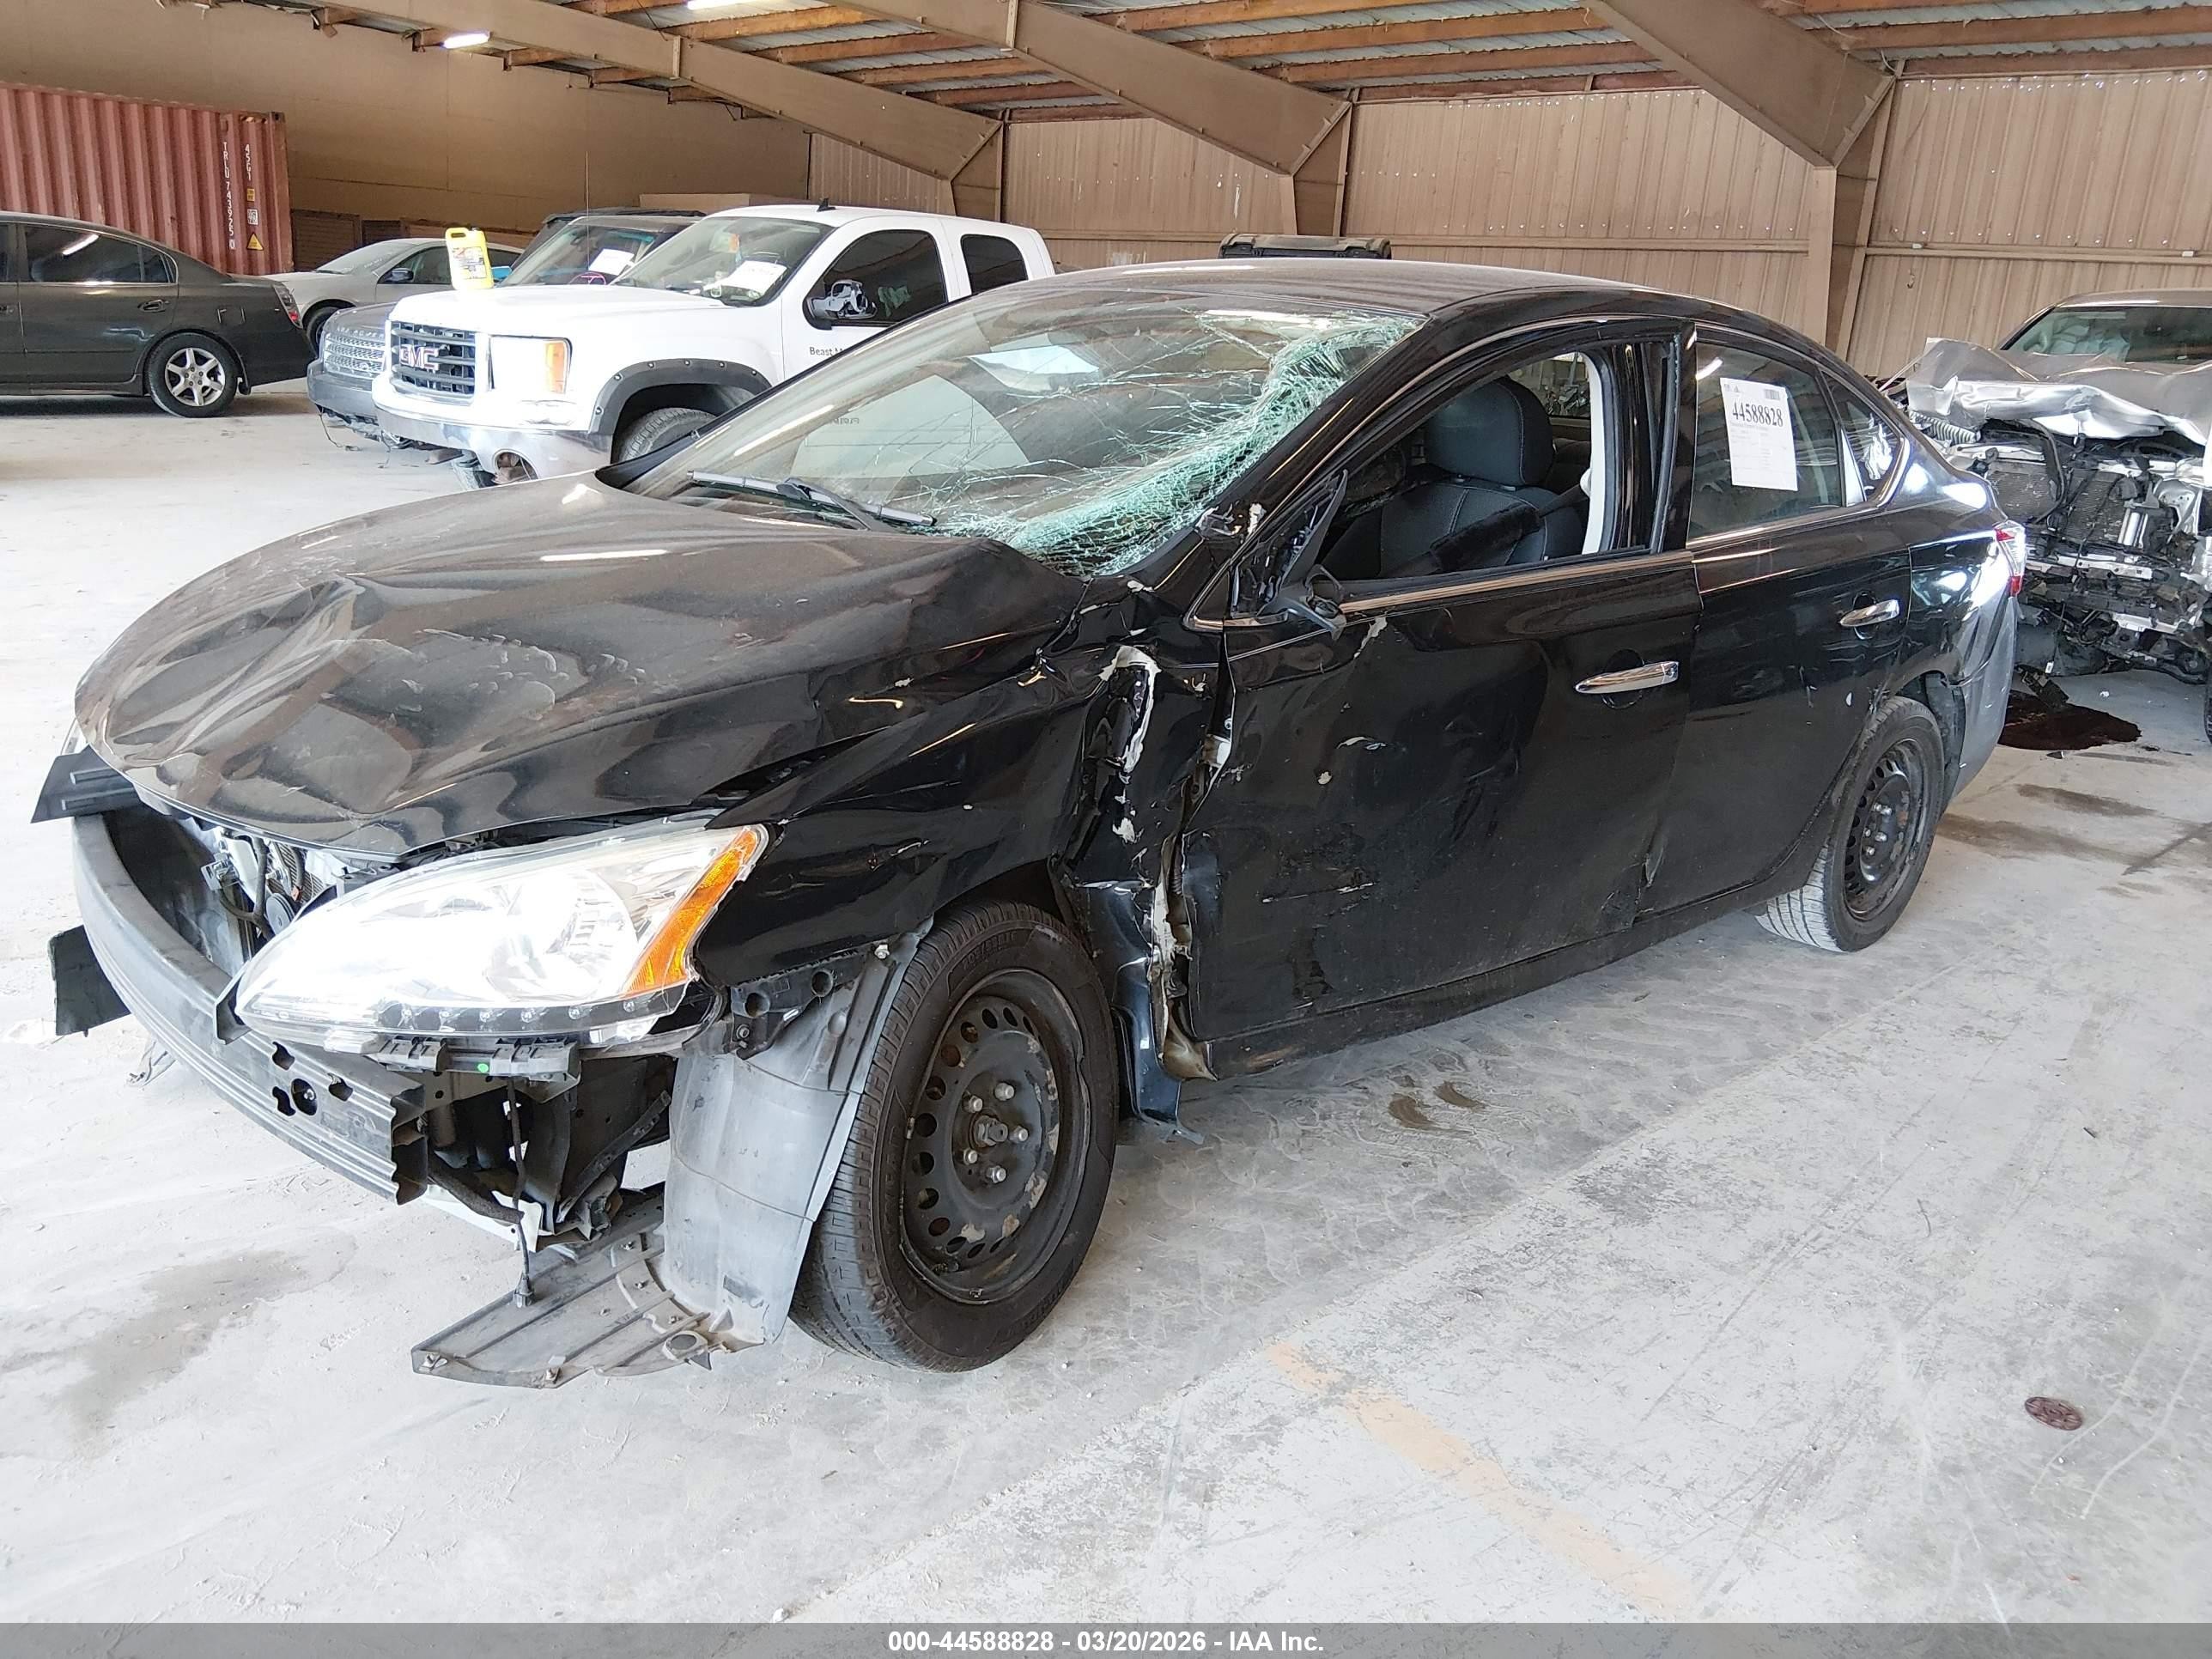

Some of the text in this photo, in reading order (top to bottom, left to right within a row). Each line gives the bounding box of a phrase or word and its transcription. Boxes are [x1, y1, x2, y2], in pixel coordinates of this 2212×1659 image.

[226, 181, 234, 236] 743925
[399, 344, 440, 371] GMC
[809, 346, 833, 356] Beast
[1732, 401, 1784, 428] 44588828
